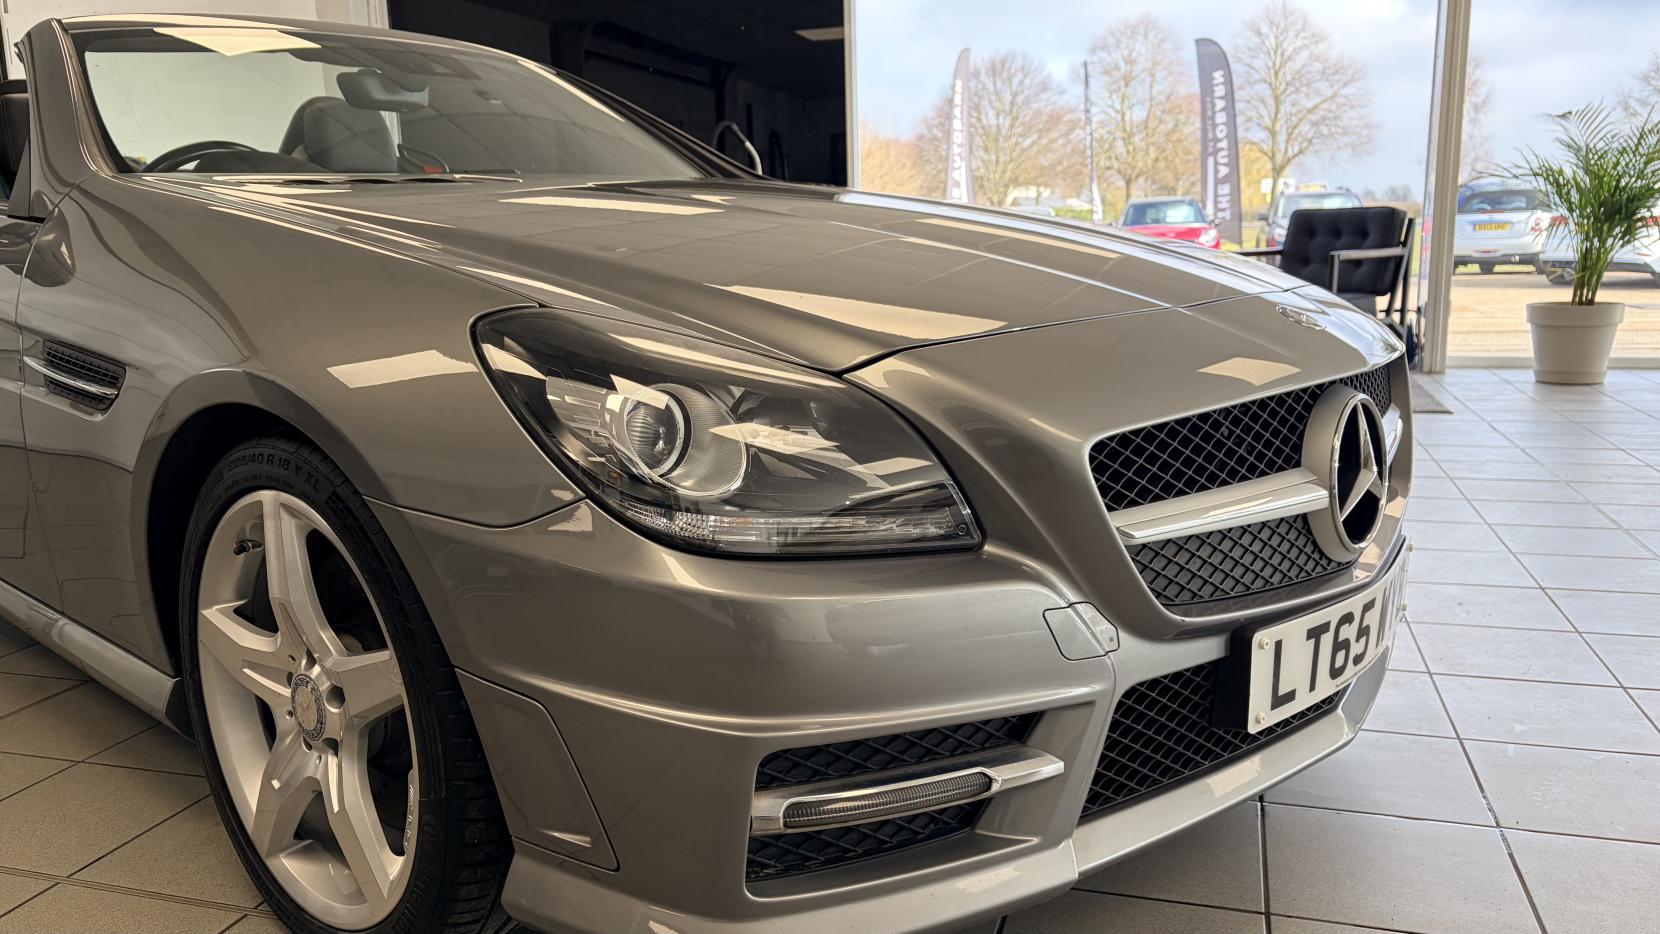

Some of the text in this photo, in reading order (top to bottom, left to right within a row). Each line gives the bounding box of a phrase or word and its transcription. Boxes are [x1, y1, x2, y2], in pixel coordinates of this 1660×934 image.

[266, 455, 274, 466] R
[277, 457, 291, 471] 18
[1270, 597, 1377, 711] LT65
